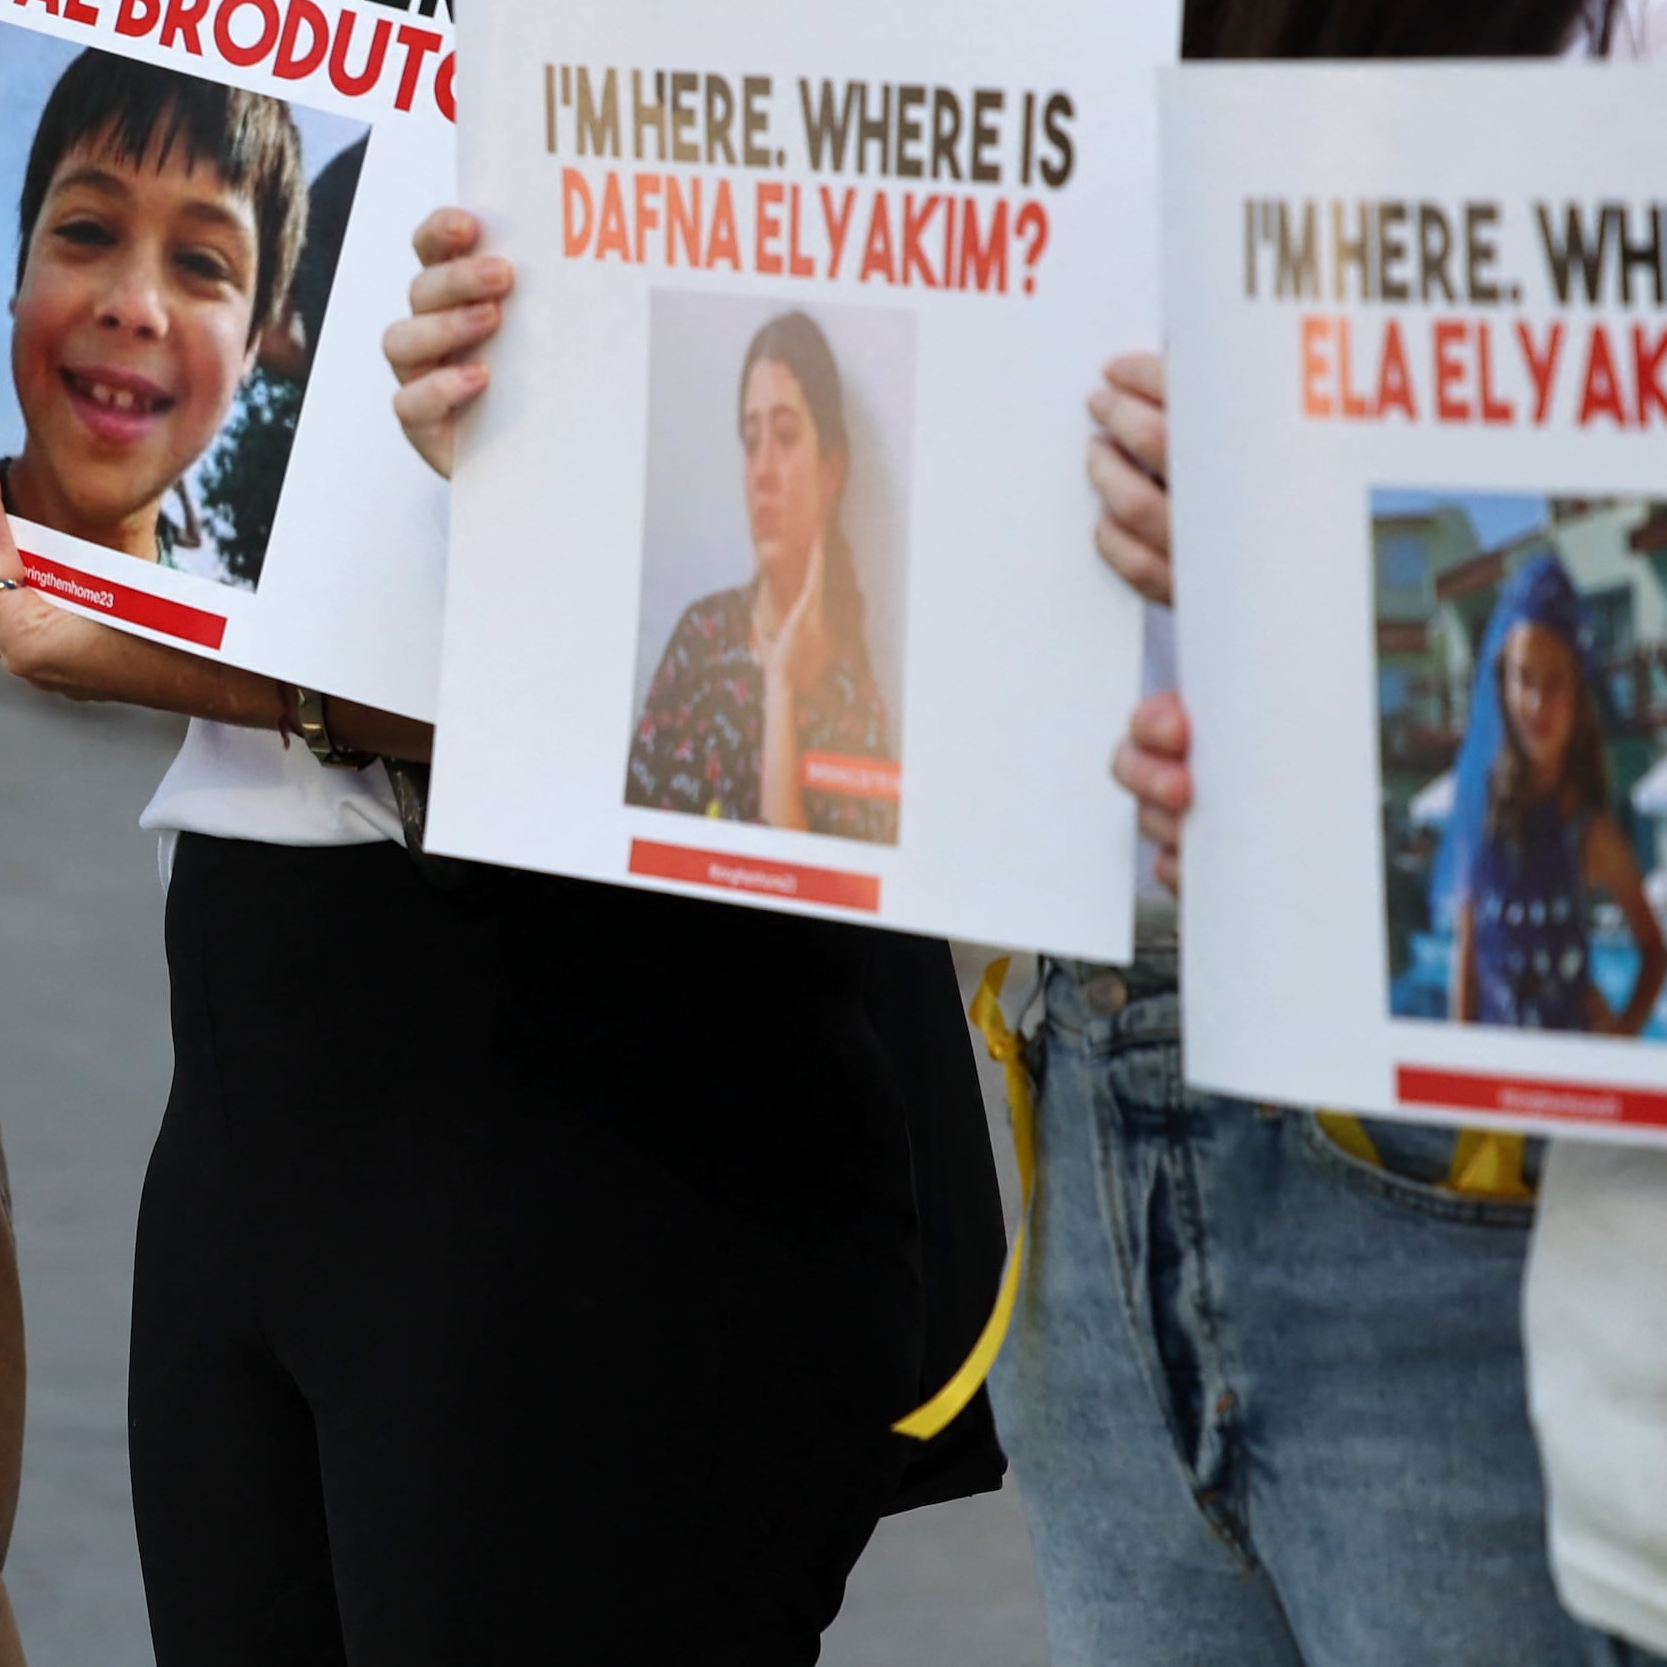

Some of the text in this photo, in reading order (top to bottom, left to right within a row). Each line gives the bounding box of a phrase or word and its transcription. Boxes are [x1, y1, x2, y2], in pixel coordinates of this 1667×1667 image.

[544, 63, 1078, 190] I'M HERE. WHERE IS
[561, 166, 1052, 298] DAFNA ELYAKIM?
[1244, 197, 1321, 302] I'M
[1332, 199, 1522, 305] HERE.
[1300, 313, 1416, 422] ELA
